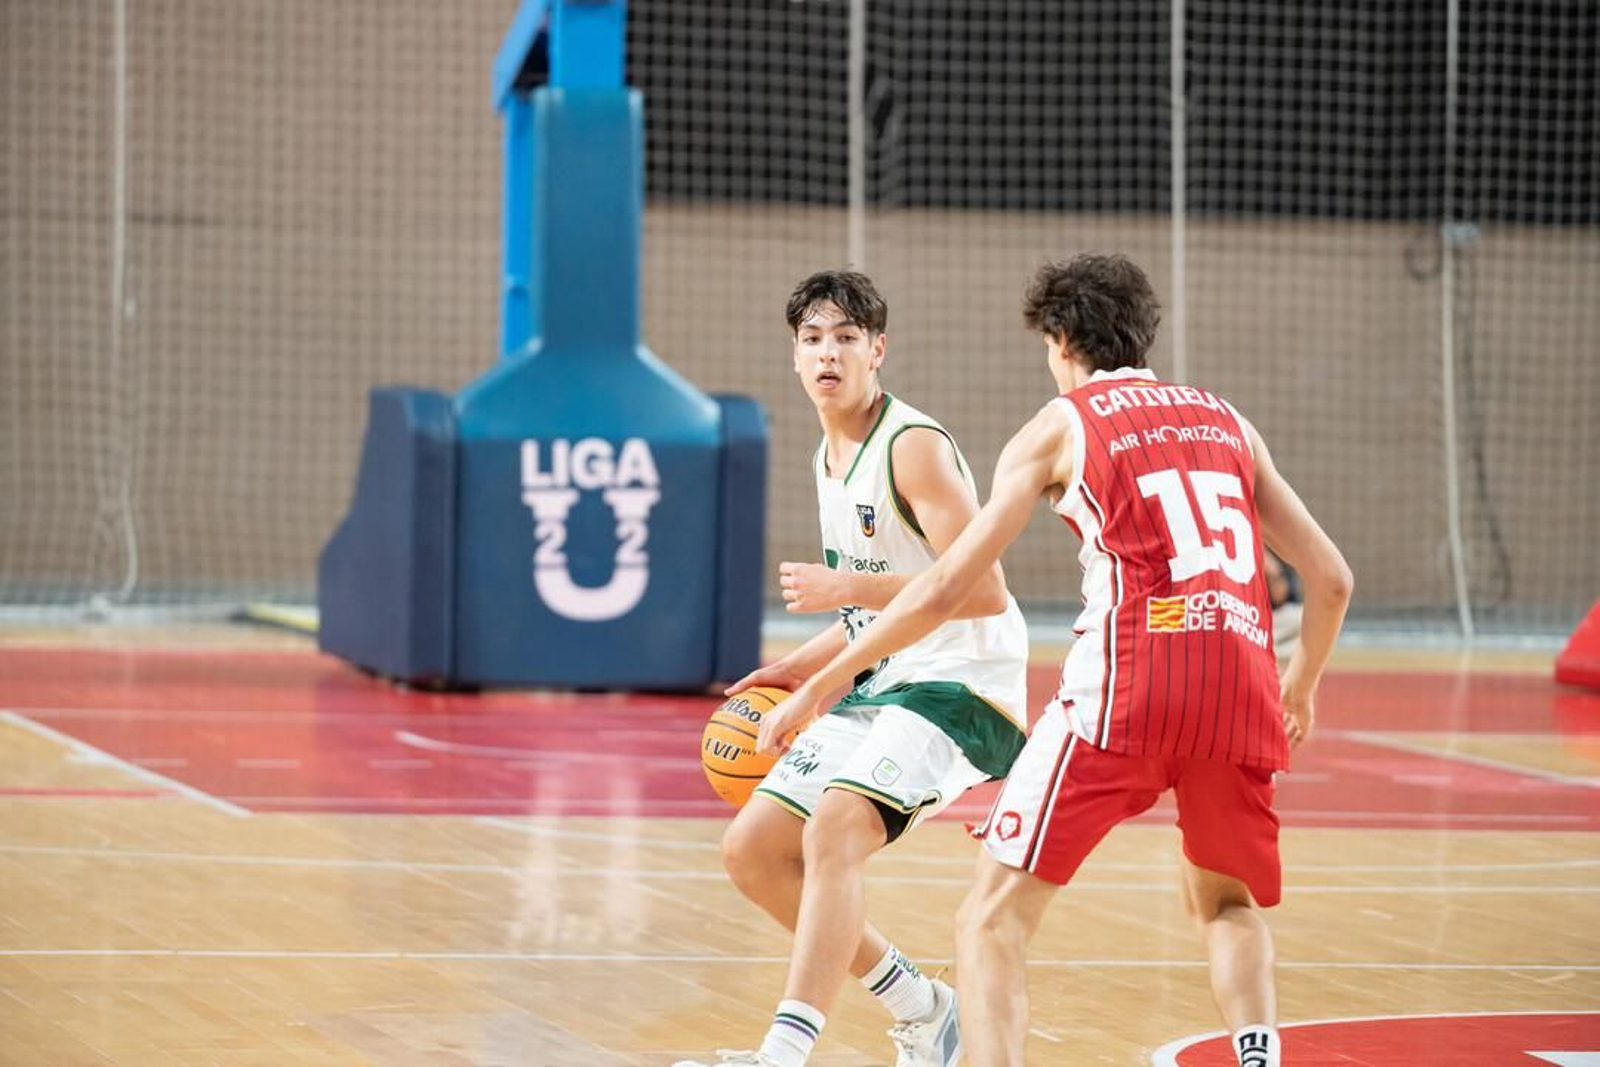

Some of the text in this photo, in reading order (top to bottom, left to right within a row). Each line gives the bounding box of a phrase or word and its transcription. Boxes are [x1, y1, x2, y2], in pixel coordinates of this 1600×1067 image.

[1110, 433, 1142, 456] AIR
[520, 437, 660, 489] LIGA
[1135, 468, 1256, 585] 15
[1187, 611, 1217, 631] DE
[718, 698, 762, 723] ilso
